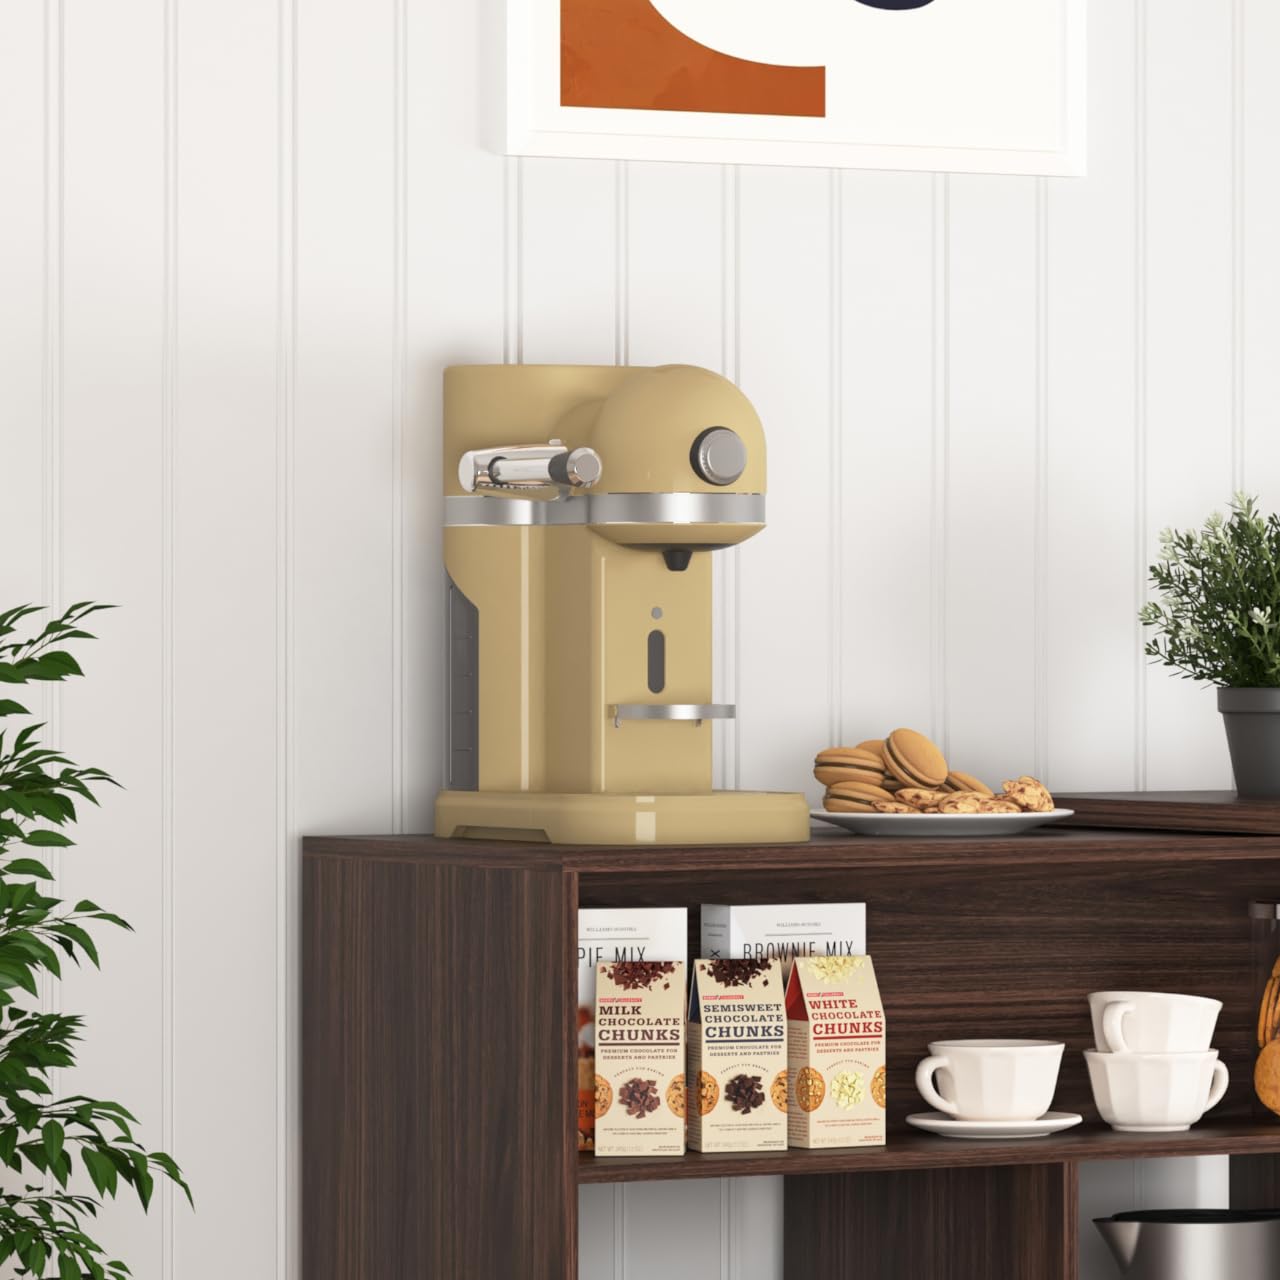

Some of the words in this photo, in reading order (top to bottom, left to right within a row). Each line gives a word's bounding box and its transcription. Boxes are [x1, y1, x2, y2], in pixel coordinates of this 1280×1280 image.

[743, 941, 817, 962] BROWNIE
[826, 940, 854, 957] MIX
[703, 1003, 782, 1013] SEMISWEET
[808, 999, 858, 1010] WHITE
[599, 1005, 642, 1016] MILK
[811, 1010, 882, 1021] CHOCOLATE
[598, 1017, 681, 1026] CHOCOLATE
[704, 1014, 784, 1023] CHOCOLATE
[705, 1025, 784, 1038] CHUNKS
[813, 1021, 883, 1035] CHUNKS
[598, 1029, 681, 1041] CHUNKS
